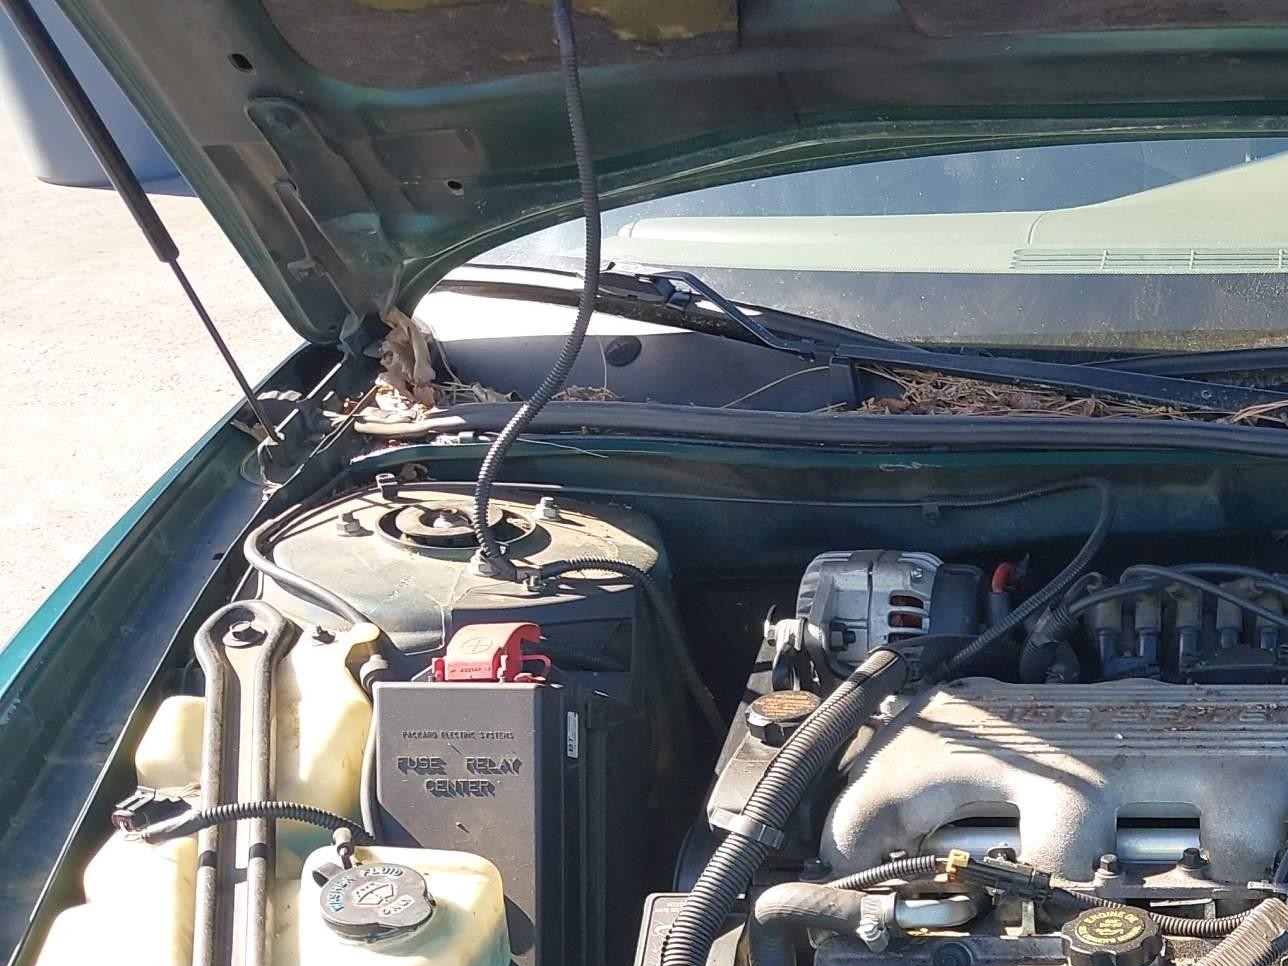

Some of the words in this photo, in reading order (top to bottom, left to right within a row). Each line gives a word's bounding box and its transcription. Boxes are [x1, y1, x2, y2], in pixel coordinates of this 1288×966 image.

[397, 755, 448, 776] FUSE
[464, 755, 523, 776] RELAY
[424, 778, 496, 799] CENTER
[360, 866, 405, 879] FLUID
